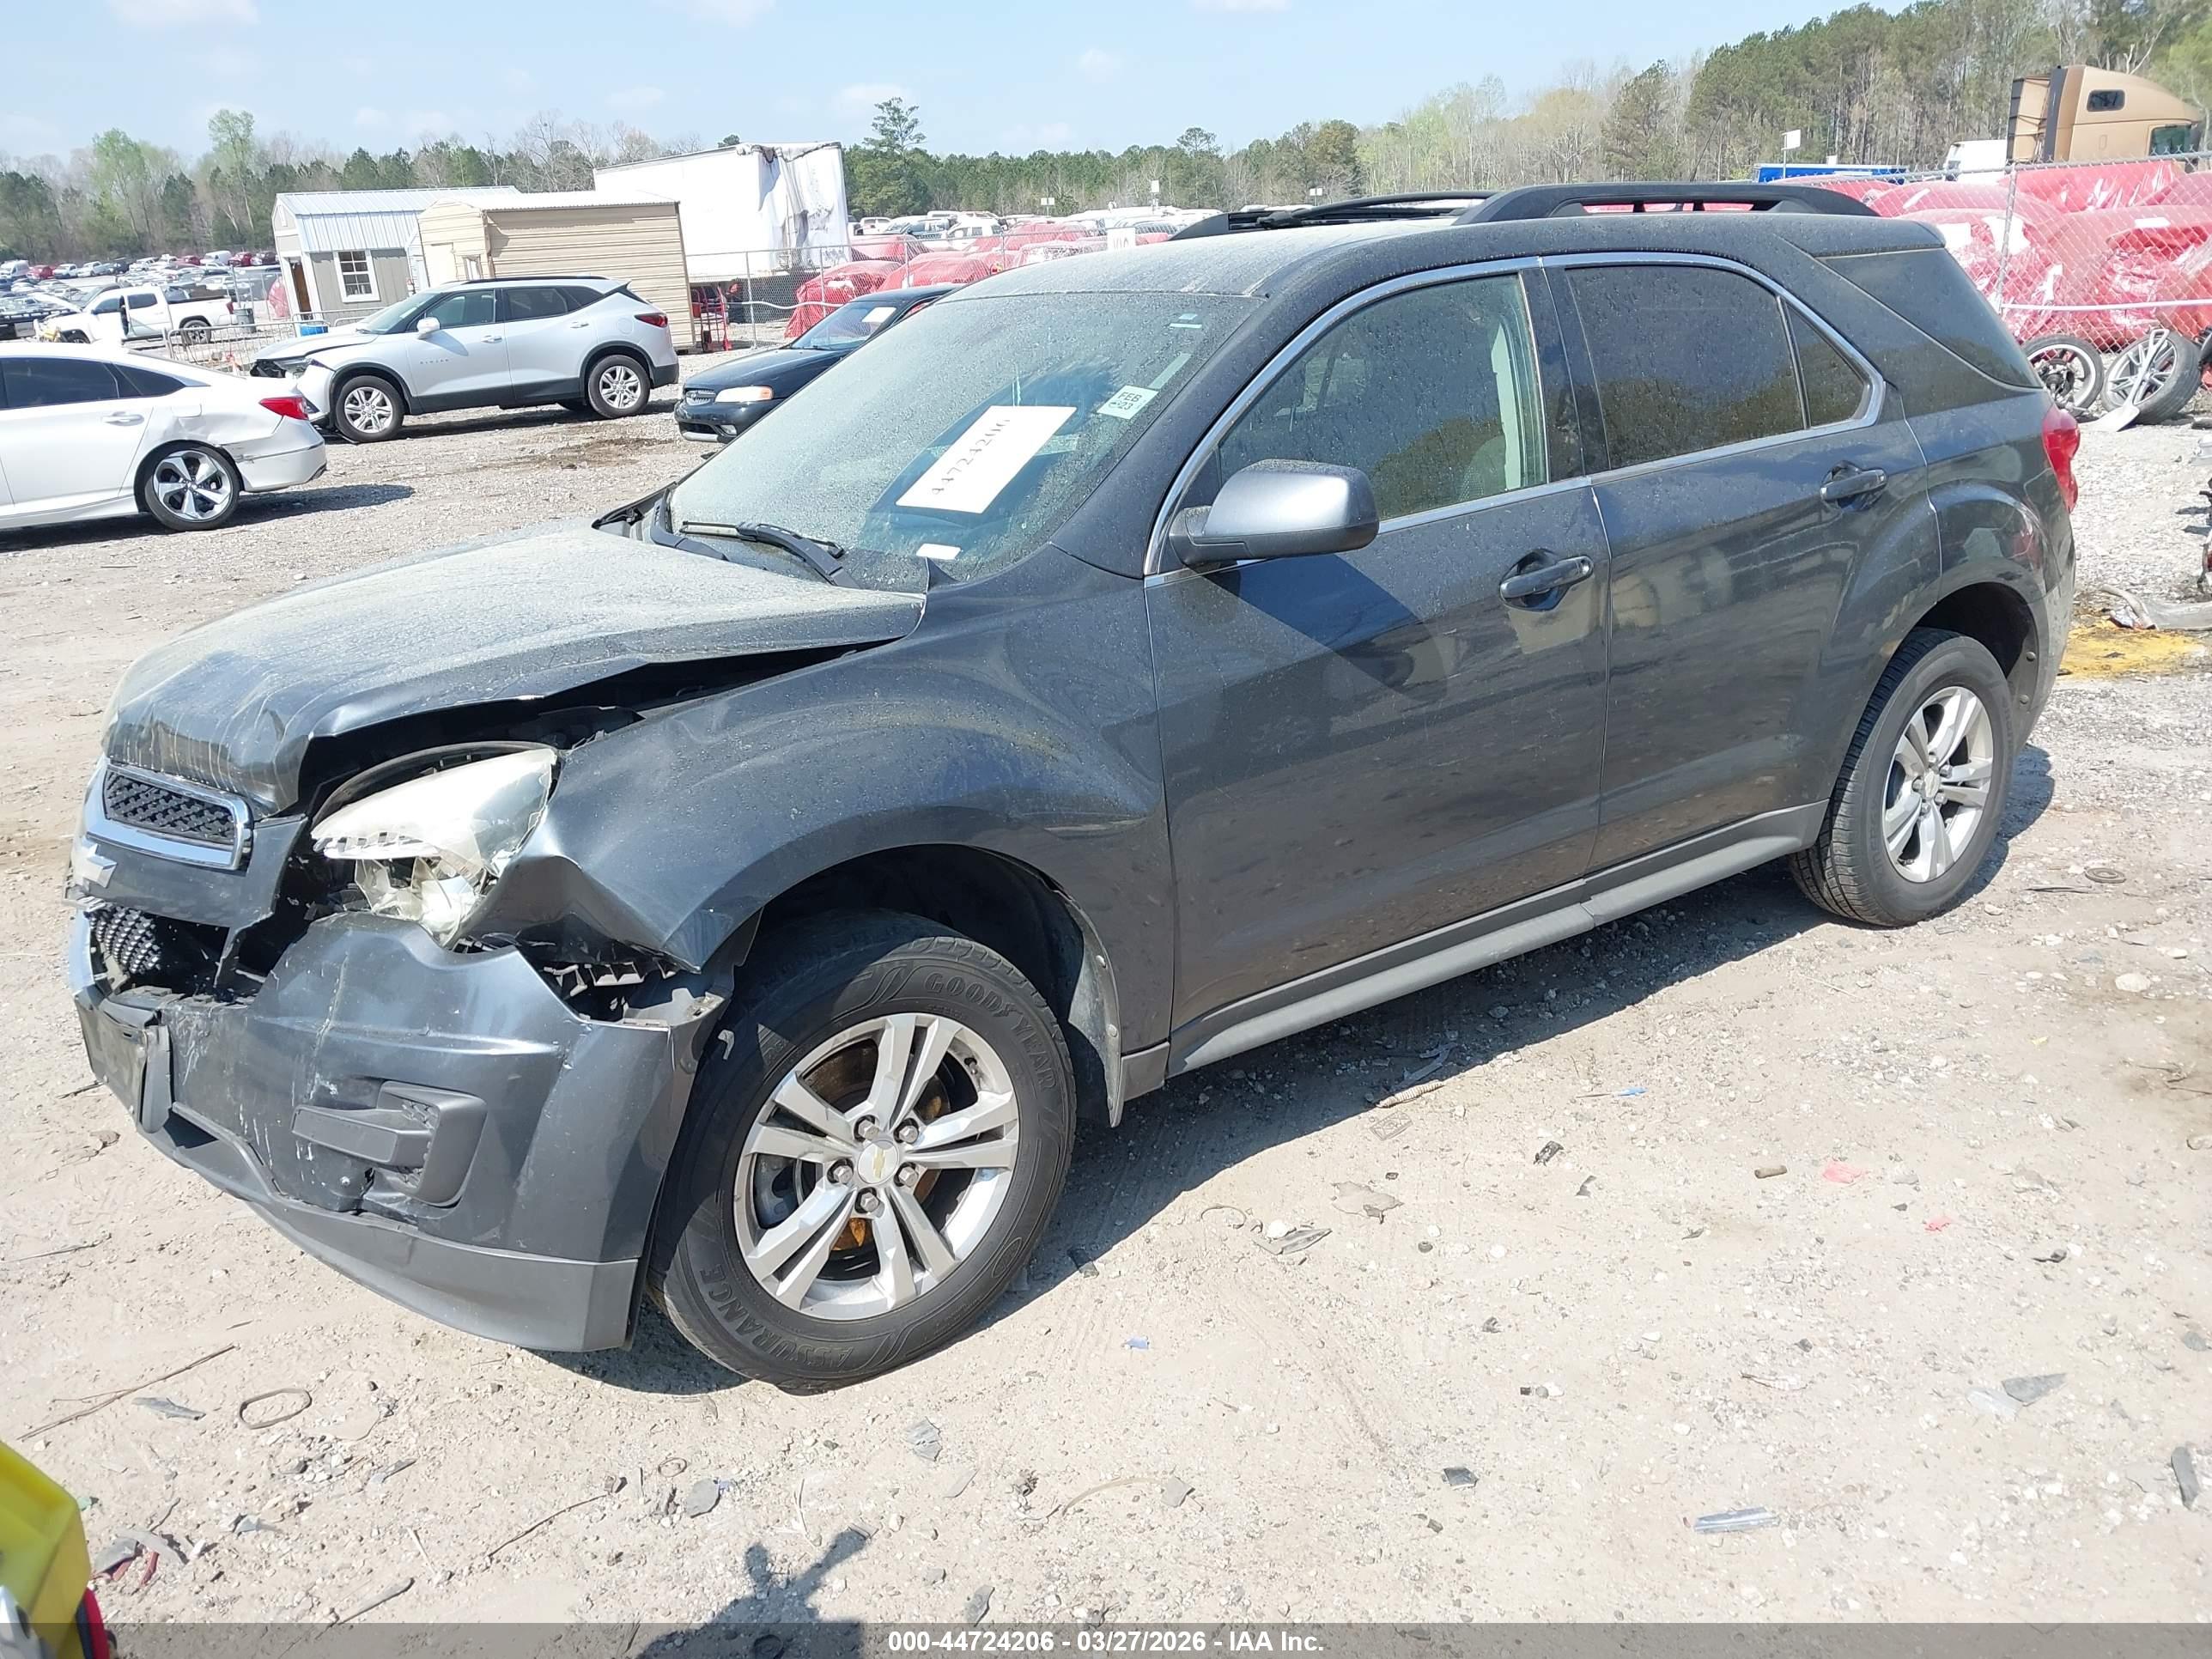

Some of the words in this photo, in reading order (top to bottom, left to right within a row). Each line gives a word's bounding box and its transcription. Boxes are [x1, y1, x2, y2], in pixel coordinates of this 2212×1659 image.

[1117, 392, 1143, 403] FEB
[925, 972, 1058, 1091] GOODYEAR
[698, 1263, 854, 1369] ASSURANCE
